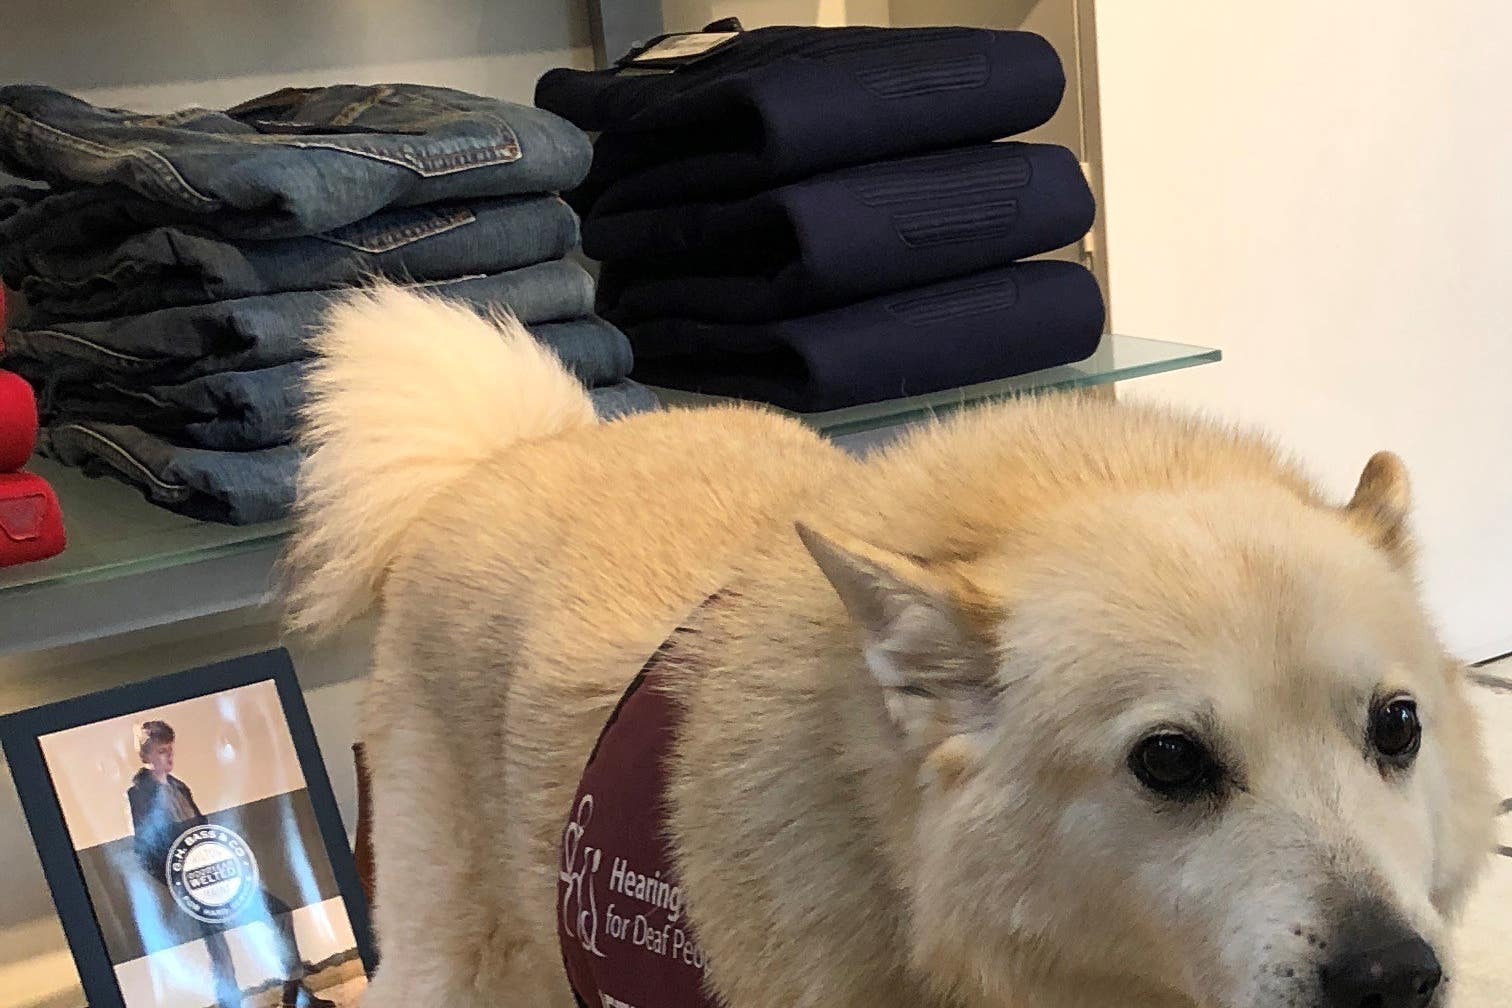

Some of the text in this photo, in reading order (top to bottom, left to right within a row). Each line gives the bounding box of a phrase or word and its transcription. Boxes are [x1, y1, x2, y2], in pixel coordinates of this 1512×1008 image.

[184, 830, 216, 847] BASS
[609, 857, 682, 922] Hearing
[605, 903, 631, 940] for
[632, 914, 671, 957] Deaf
